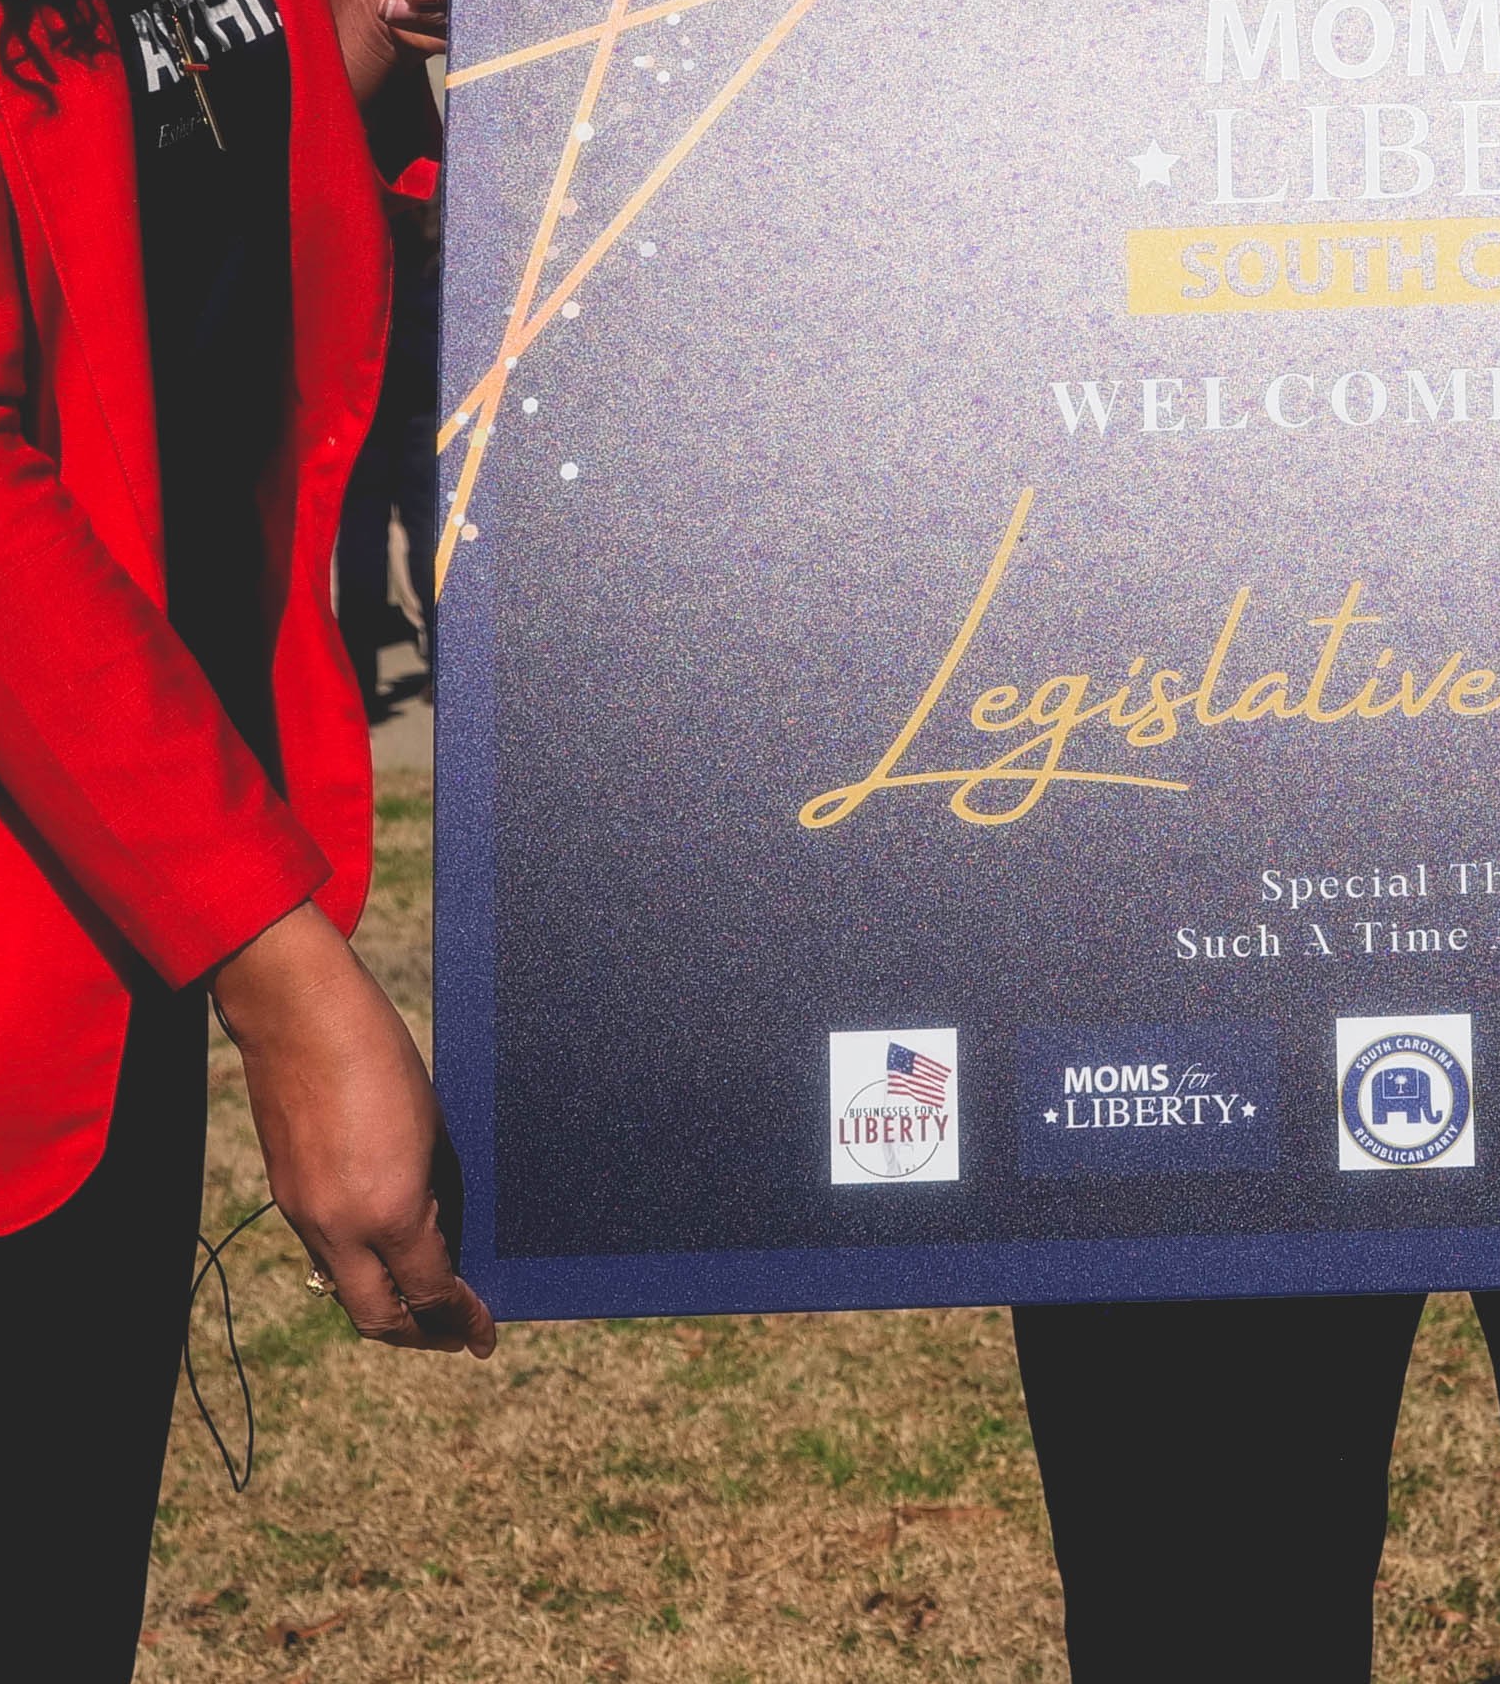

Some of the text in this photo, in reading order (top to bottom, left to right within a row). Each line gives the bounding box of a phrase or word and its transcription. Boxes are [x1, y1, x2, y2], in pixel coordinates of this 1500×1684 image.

[1180, 234, 1437, 299] SOUTH
[1261, 864, 1428, 909] Special
[1176, 924, 1280, 960] Such
[1303, 923, 1332, 956] A
[1355, 921, 1468, 954] Time
[1355, 1038, 1454, 1072] SOUTH CAROLINA
[1064, 1062, 1218, 1098] MOMS for
[849, 1106, 934, 1118] BUSINESSES FOR
[1065, 1094, 1239, 1129] LIBERTY
[839, 1115, 949, 1145] LIBERTY
[1354, 1124, 1459, 1163] REPUBLICAN PARTY
